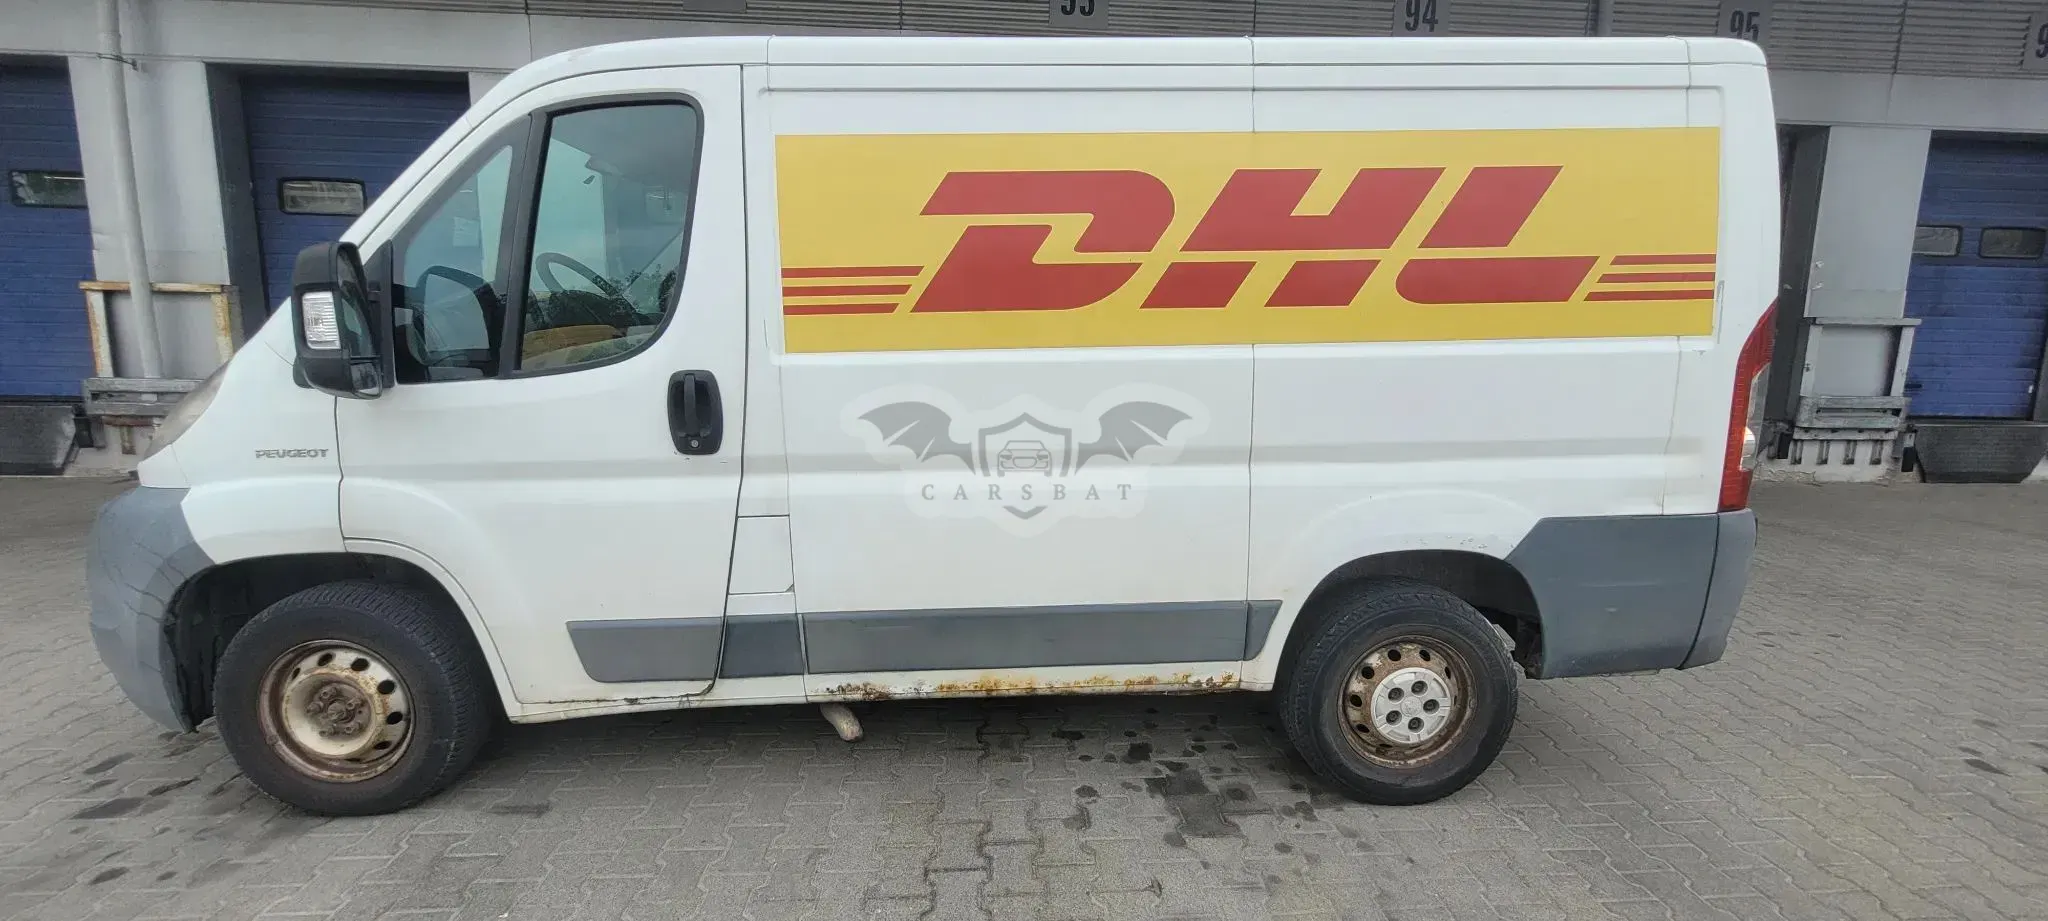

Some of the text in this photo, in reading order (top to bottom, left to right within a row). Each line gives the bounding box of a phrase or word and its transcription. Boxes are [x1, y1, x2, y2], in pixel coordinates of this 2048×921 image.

[1405, 0, 1438, 32] 94
[1730, 10, 1760, 41] 95
[909, 165, 1600, 313] DHL
[255, 448, 329, 458] PEUGEOT
